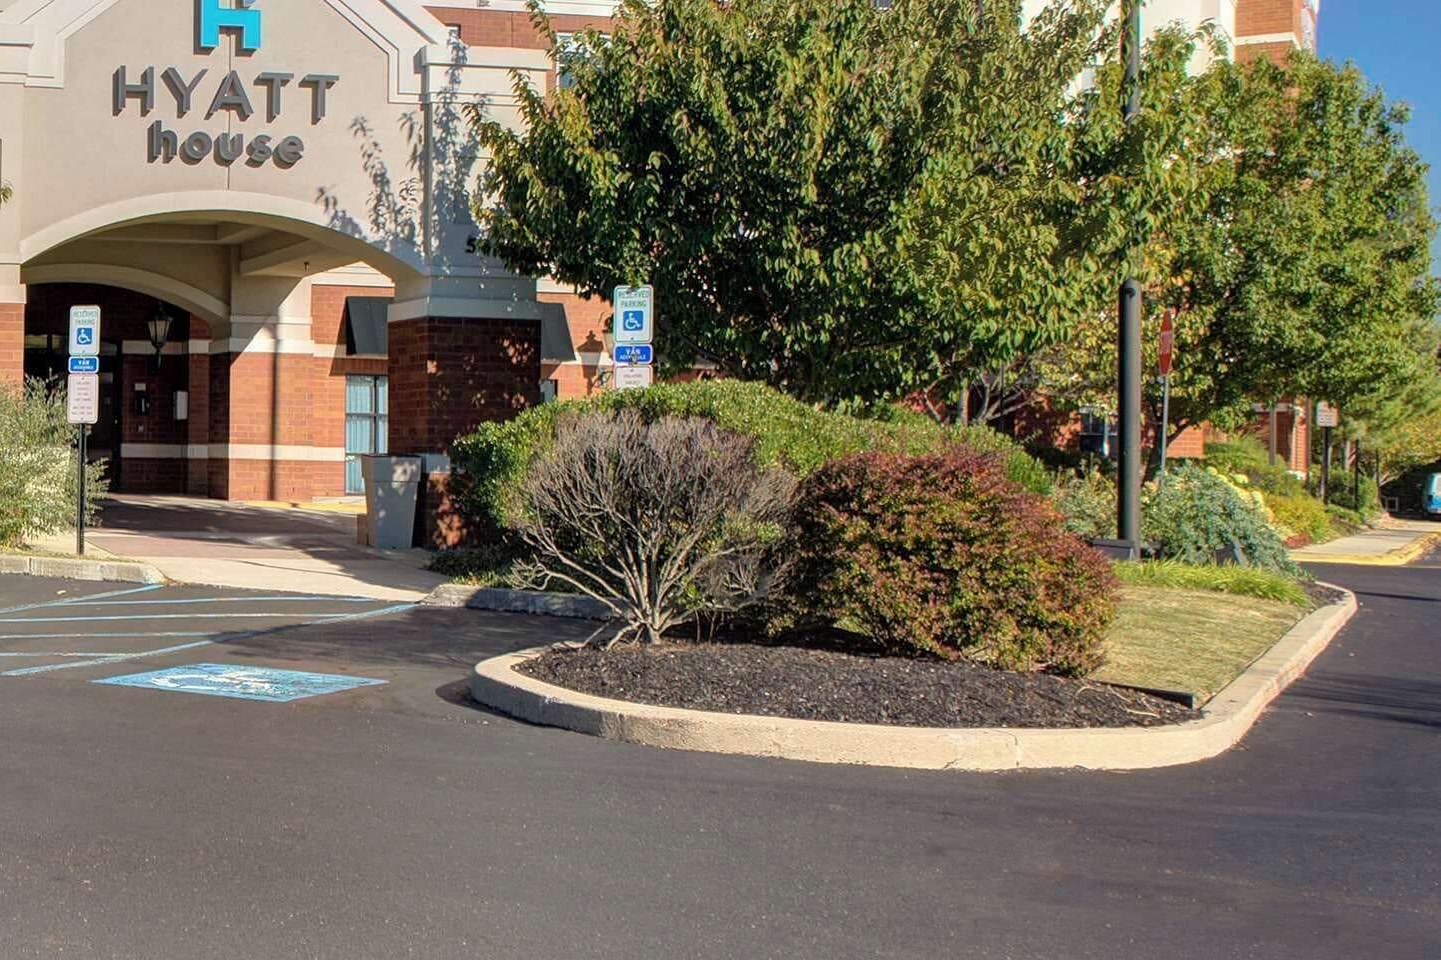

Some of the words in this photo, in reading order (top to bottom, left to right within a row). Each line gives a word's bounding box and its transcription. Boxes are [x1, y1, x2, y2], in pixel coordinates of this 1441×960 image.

[112, 65, 340, 125] HYATT
[146, 120, 305, 169] house
[621, 300, 647, 308] PARKING
[625, 347, 641, 355] VAN
